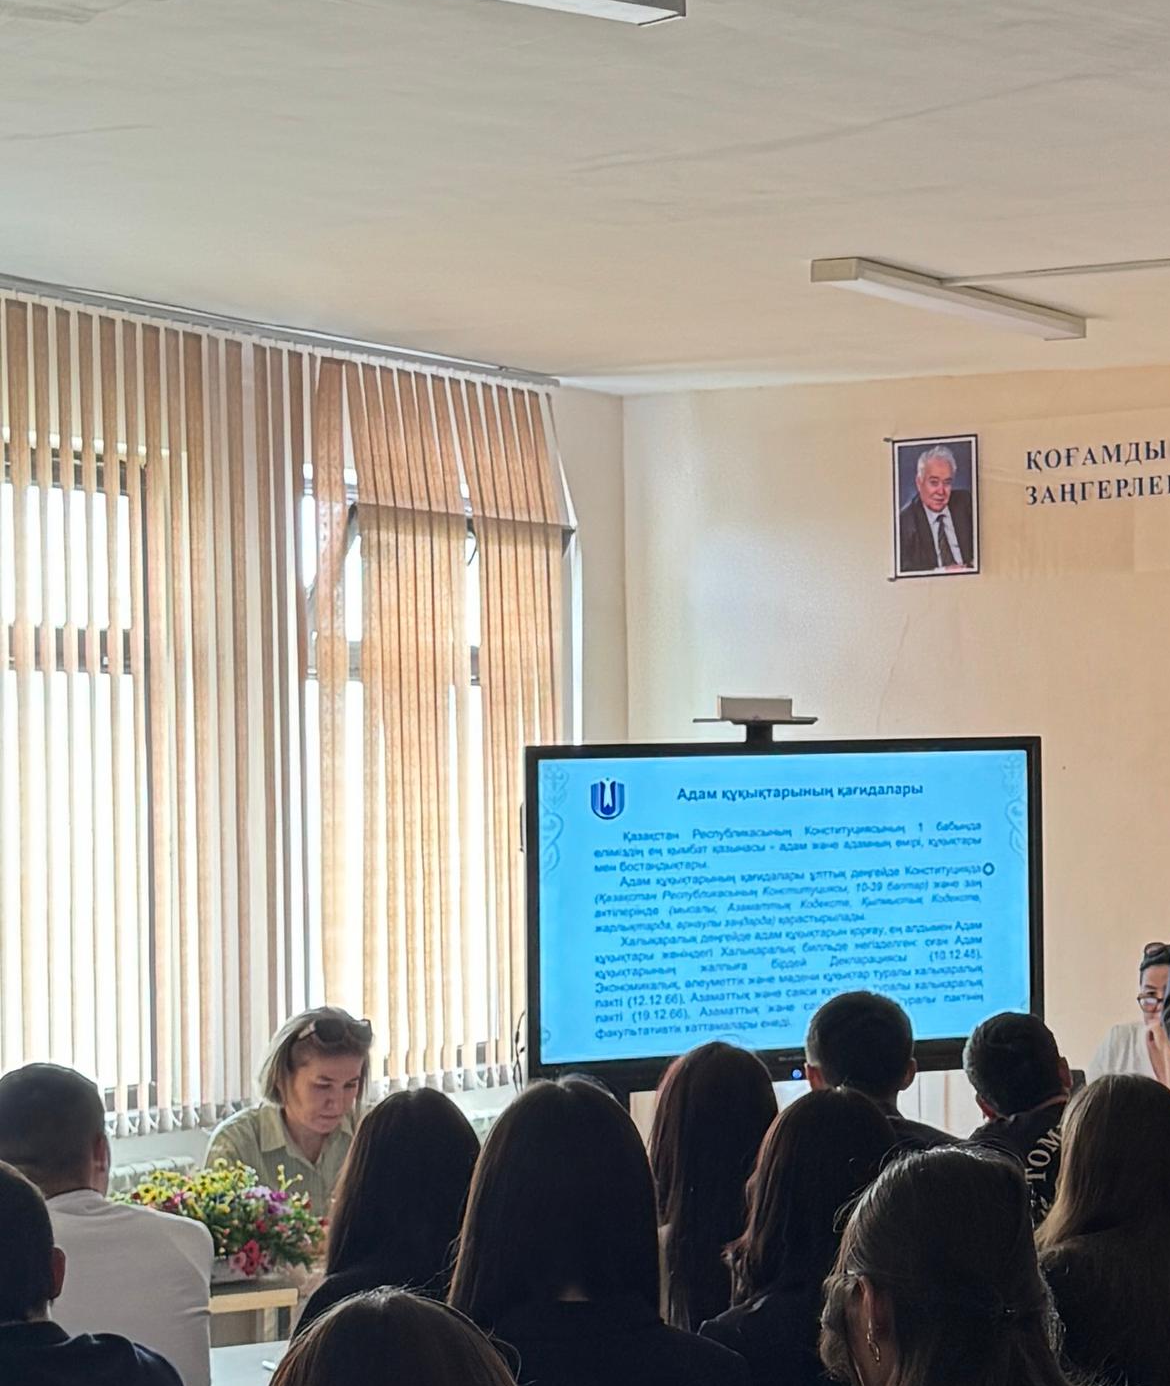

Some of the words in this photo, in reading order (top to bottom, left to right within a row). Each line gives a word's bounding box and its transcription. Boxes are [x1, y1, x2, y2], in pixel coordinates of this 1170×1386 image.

[1025, 439, 1166, 472] ҚОҒАМДЫ
[677, 787, 718, 802] Адам
[618, 875, 650, 887] Адам
[953, 919, 982, 932] Адам
[953, 933, 982, 946] Адам
